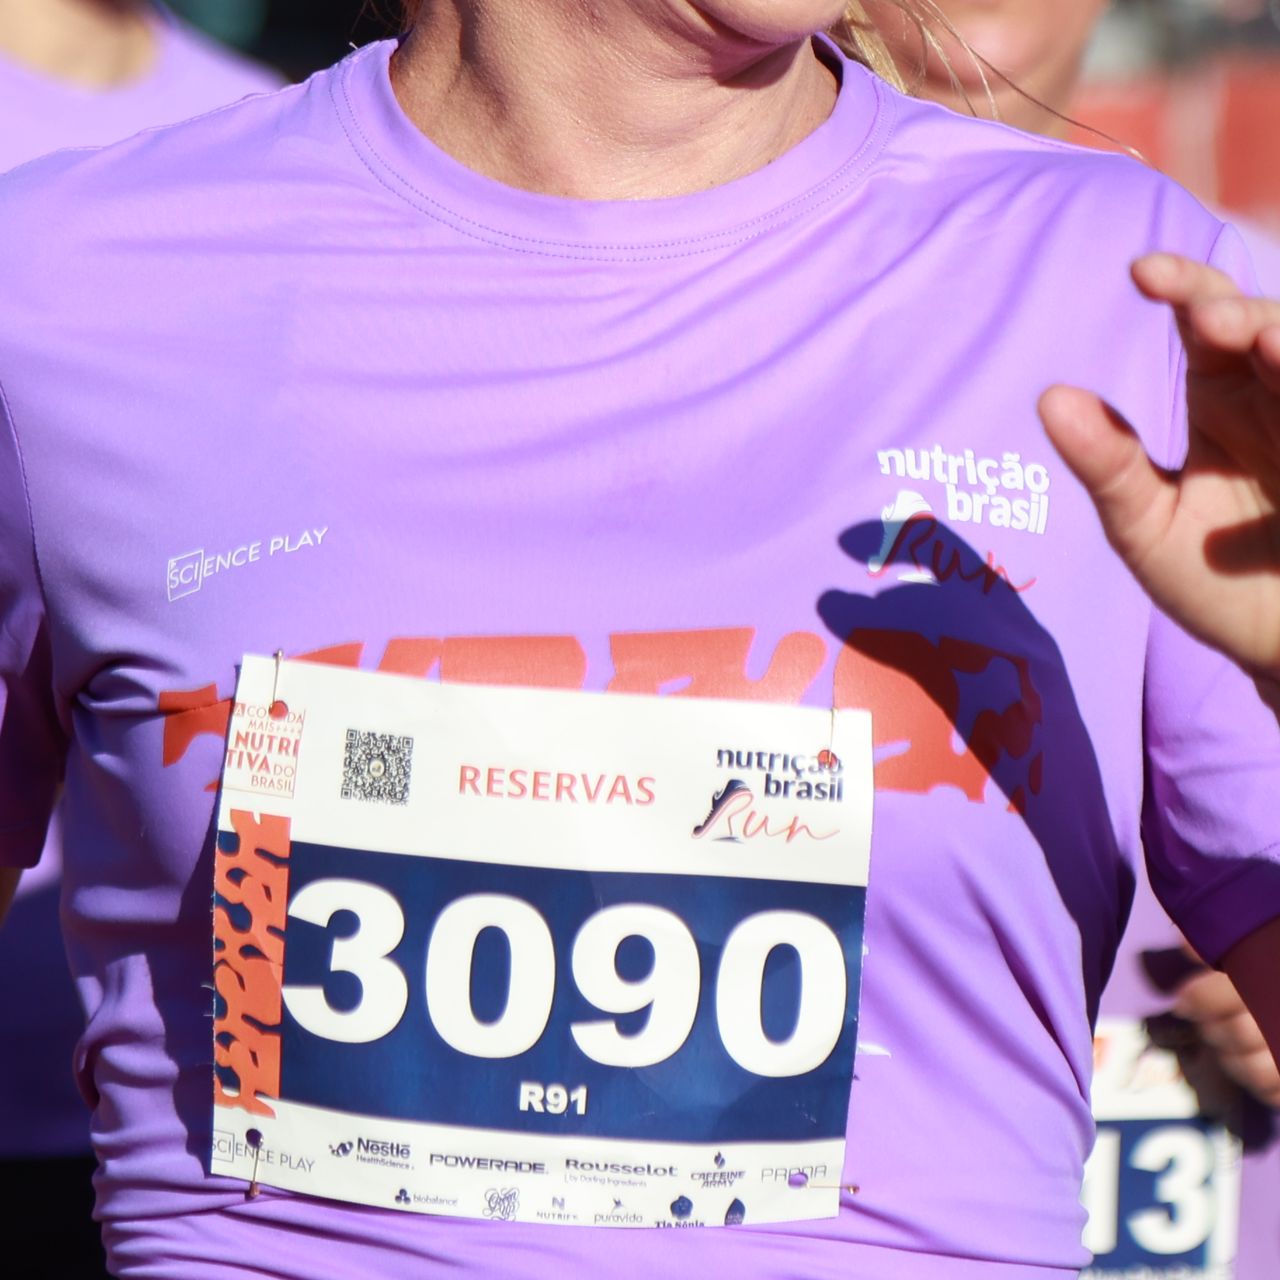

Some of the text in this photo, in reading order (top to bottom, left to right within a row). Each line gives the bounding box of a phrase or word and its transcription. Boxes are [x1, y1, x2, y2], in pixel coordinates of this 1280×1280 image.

[877, 444, 1051, 495] nutrição
[946, 483, 1050, 535] brasil
[169, 526, 328, 589] SCIENCE PLAY
[867, 511, 1037, 595] Run
[247, 705, 303, 724] CODA
[248, 720, 276, 731] MAIS
[234, 730, 301, 757] NUTRI
[227, 749, 295, 777] TIVA DO
[250, 775, 293, 792] BRASIL
[459, 764, 656, 806] RESERVAS
[764, 773, 843, 801] brasil
[692, 790, 841, 843] Run
[281, 878, 847, 1078] 3090
[519, 1081, 588, 1115] R91
[357, 1137, 411, 1159] Nestlé
[280, 1152, 315, 1173] PLAY
[430, 1153, 546, 1174] POWERADE
[565, 1158, 679, 1177] Rousselot
